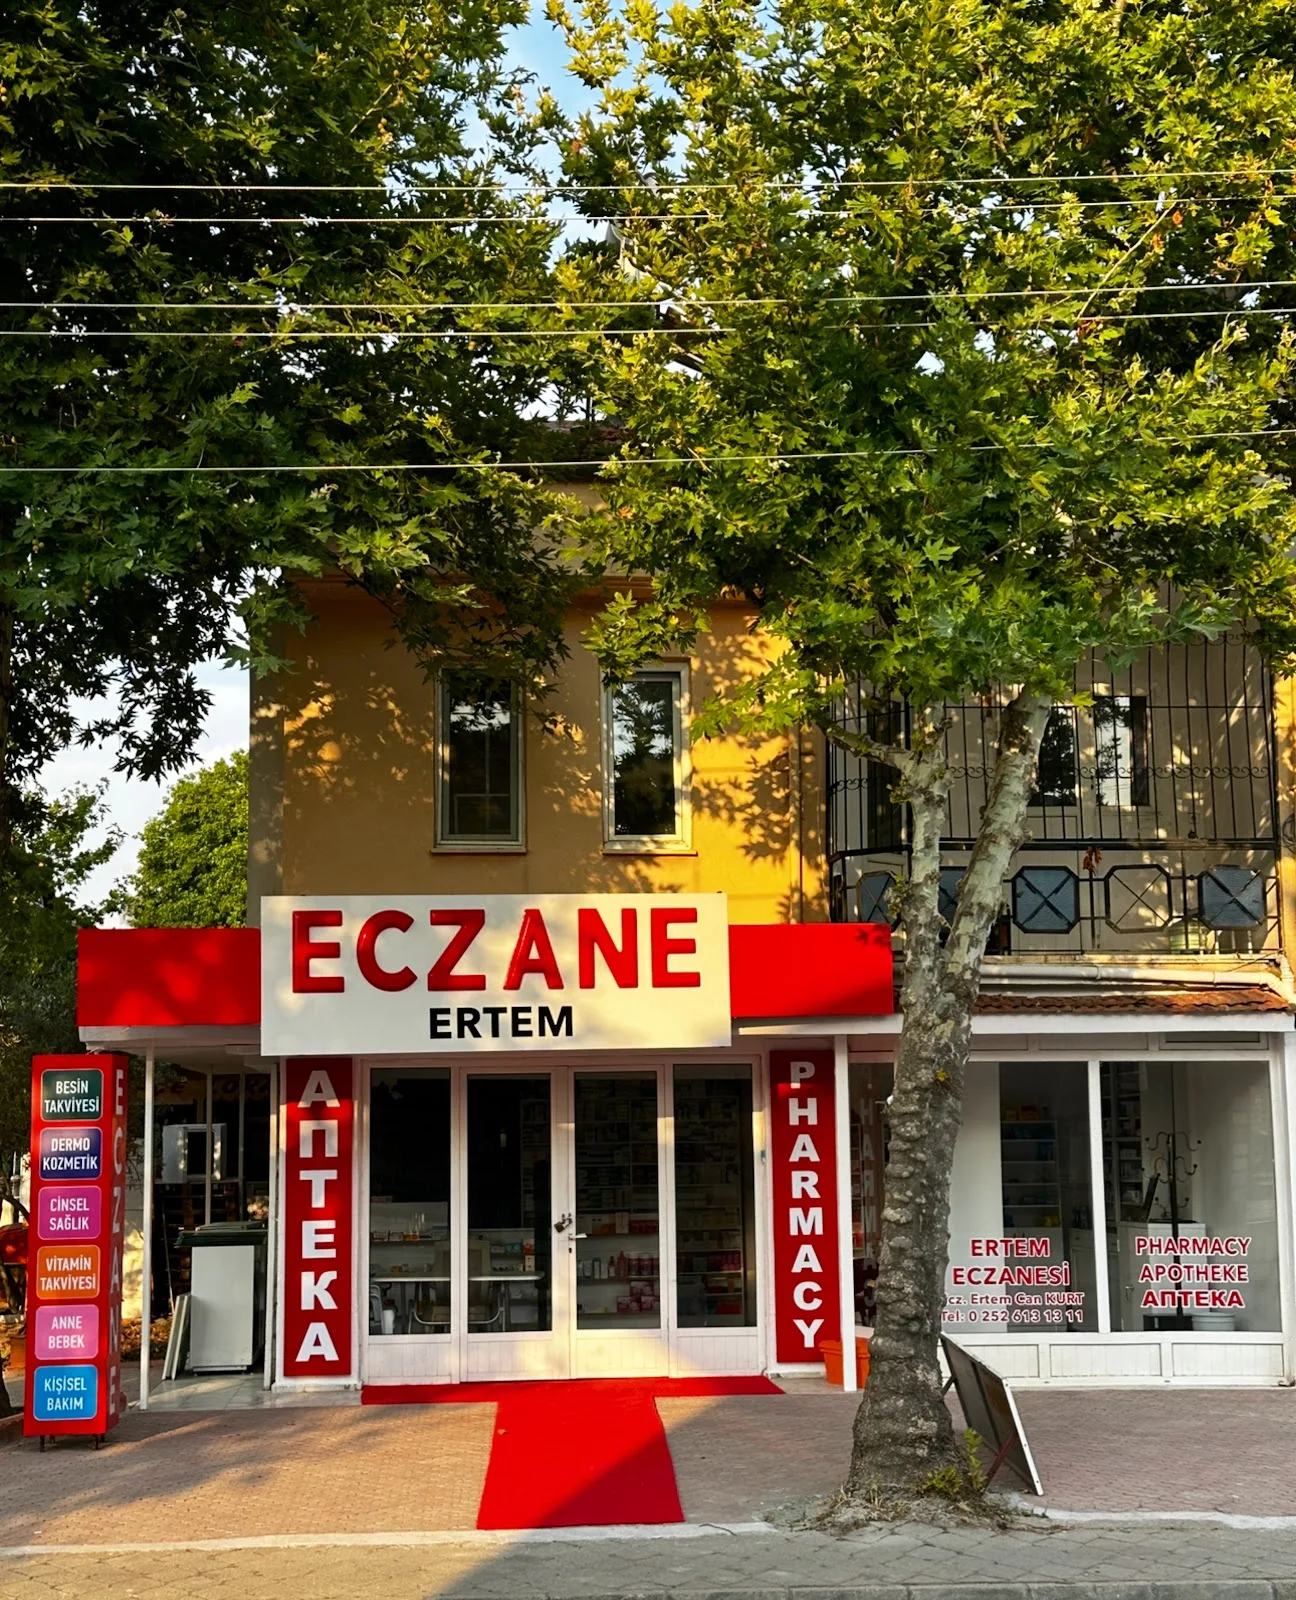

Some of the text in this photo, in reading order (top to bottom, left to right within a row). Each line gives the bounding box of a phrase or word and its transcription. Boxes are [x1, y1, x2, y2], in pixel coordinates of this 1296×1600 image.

[292, 907, 701, 993] ECZANE
[429, 1005, 573, 1040] ERTEM
[55, 1077, 89, 1094] BESİN
[44, 1095, 99, 1113] TAKVİYESİ
[51, 1137, 90, 1152] DERMO
[43, 1152, 98, 1171] KOZMETİK
[50, 1194, 89, 1212] CİNSEL
[788, 1061, 825, 1348] PHARMACY
[49, 1213, 89, 1231] SAĞLIK
[295, 1070, 340, 1362] АПТЕКА
[108, 1069, 124, 1416] ECZANE
[970, 1238, 1050, 1258] ERTEM
[1135, 1236, 1251, 1256] PHARMACY
[46, 1254, 91, 1272] VİTAMİN
[40, 1273, 96, 1291] TAKVİYESİ
[952, 1261, 1071, 1286] ECZANESİ
[1138, 1263, 1249, 1283] APOTHEKE
[945, 1293, 1084, 1306] cz. Ertem Can KURT
[1141, 1289, 1244, 1308] АПТЕКА
[51, 1315, 82, 1330] ANNE
[968, 1310, 977, 1323] 0
[982, 1310, 1008, 1323] 252
[1012, 1310, 1040, 1323] 613
[1043, 1310, 1063, 1323] 13
[1066, 1310, 1084, 1323] 11
[48, 1334, 85, 1350] BEBEK
[44, 1376, 87, 1395] KİŞİSEL
[46, 1396, 83, 1411] BAKIM
